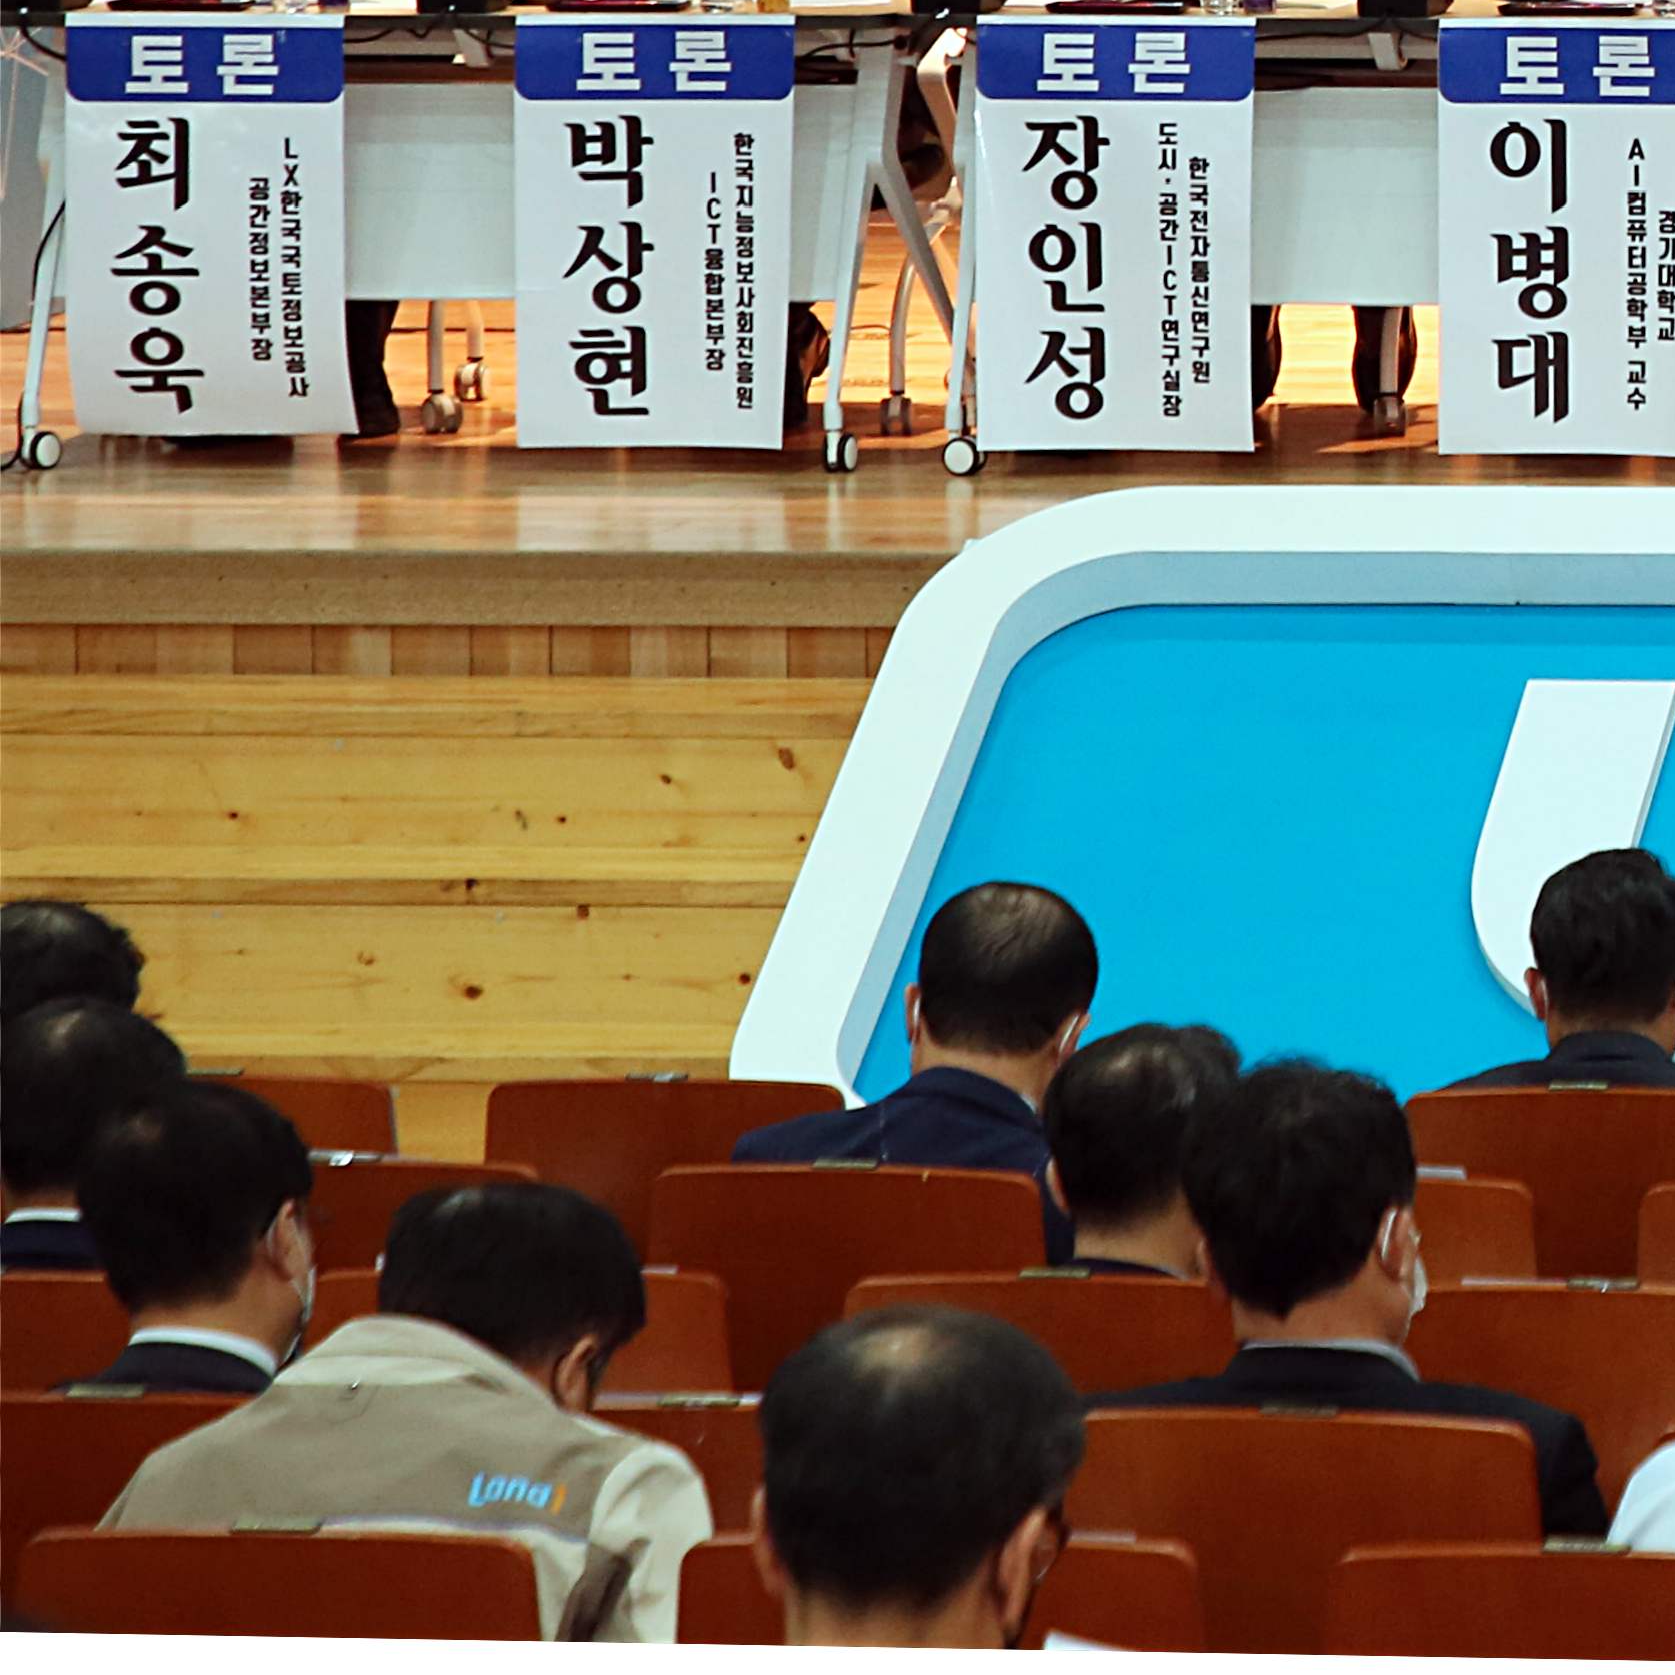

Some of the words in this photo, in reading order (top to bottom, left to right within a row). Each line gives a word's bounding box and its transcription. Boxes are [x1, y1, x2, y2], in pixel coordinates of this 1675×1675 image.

[110, 117, 205, 414] 최송욱
[248, 177, 274, 361] 공간정보본부장
[280, 137, 310, 398] LX한국국토정보공사
[563, 114, 655, 416] 박상현
[704, 171, 726, 371] ICT융합본부장
[733, 132, 756, 410] 한국지능정보사회진흥원
[1022, 115, 1111, 420] 장인성
[1188, 156, 1211, 384] 한국전자통신연구원
[1489, 118, 1570, 424] 이병대
[1626, 137, 1649, 350] AI컴퓨터공학부
[1626, 360, 1647, 411] 교수
